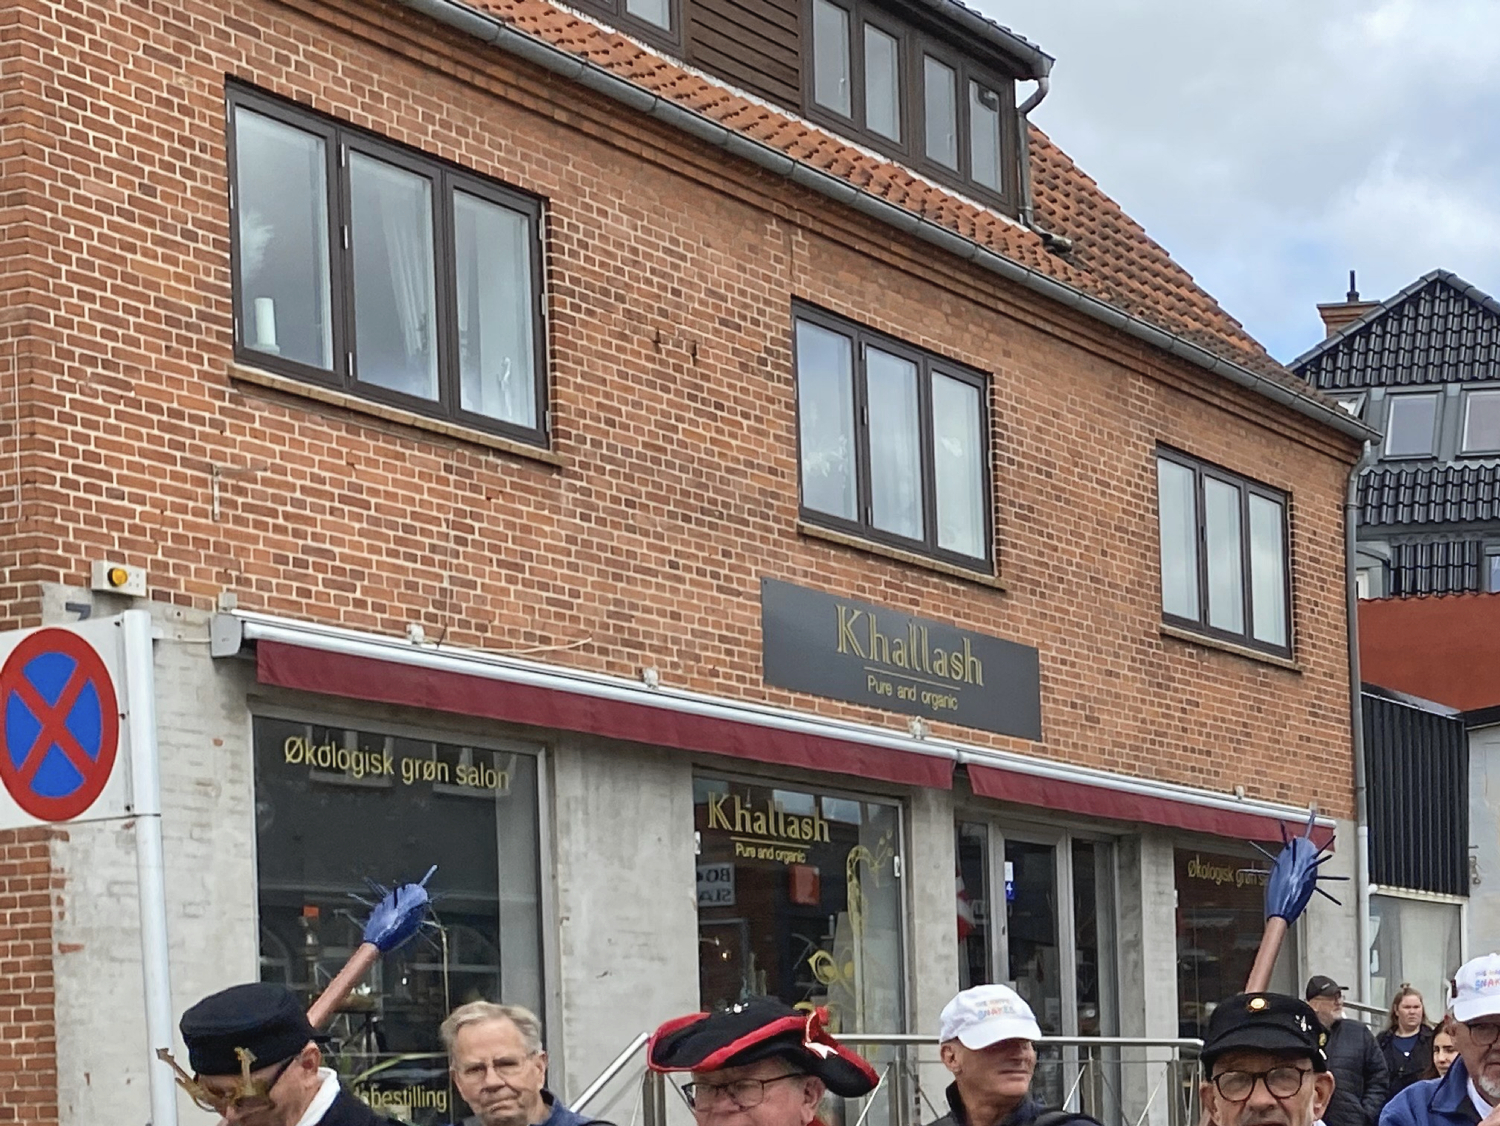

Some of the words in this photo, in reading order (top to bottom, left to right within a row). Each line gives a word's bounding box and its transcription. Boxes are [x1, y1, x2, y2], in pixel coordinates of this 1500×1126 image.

[834, 603, 985, 687] Khallash
[867, 675, 893, 697] Pure
[897, 685, 917, 702] and
[921, 691, 958, 711] organic
[284, 736, 395, 780] Økologisk
[401, 757, 450, 785] grøn
[456, 762, 510, 789] salon
[707, 790, 831, 843] Khallash
[757, 846, 774, 860] and
